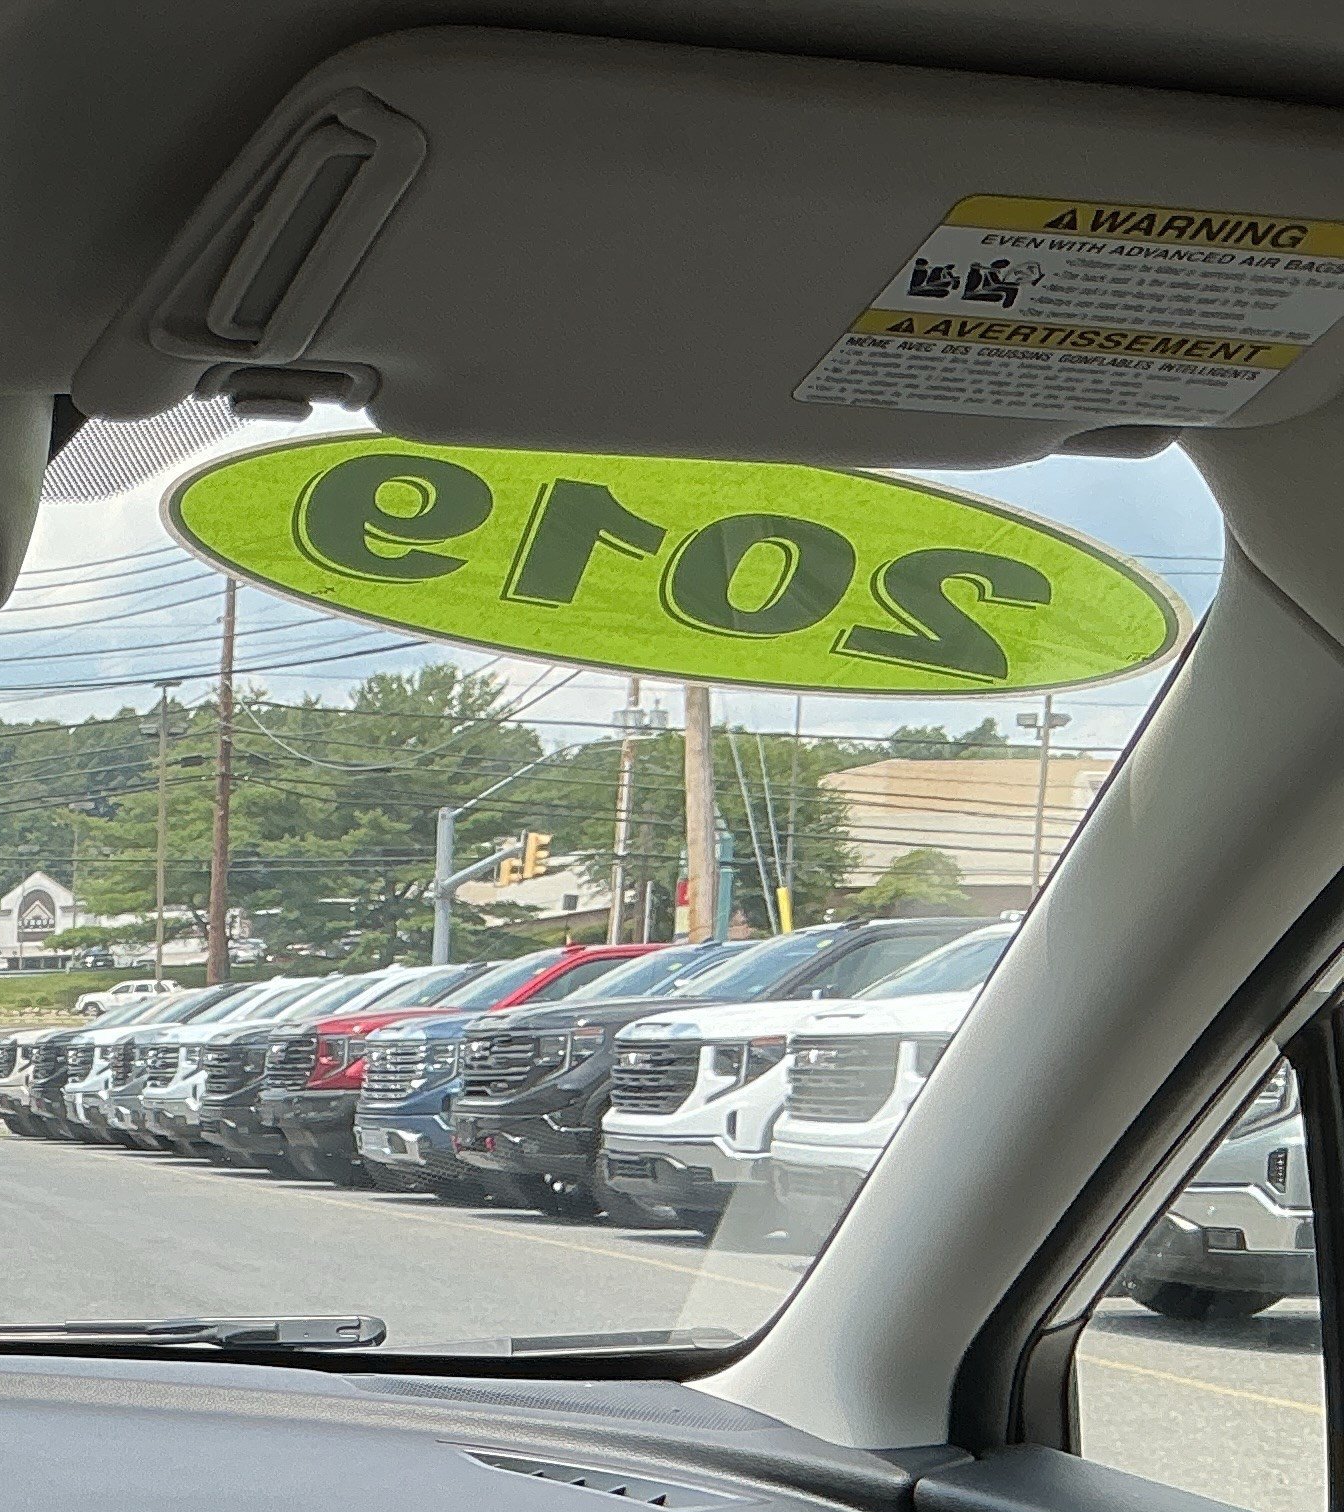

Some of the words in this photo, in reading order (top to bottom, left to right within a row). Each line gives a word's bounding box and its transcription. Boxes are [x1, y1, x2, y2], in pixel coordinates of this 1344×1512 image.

[1091, 208, 1309, 249] WARNING
[981, 234, 1044, 249] EVEN
[1048, 238, 1105, 255] WITH
[1108, 244, 1237, 266] ADVANCED
[1239, 254, 1282, 269] AIR
[1285, 259, 1344, 275] BAGS
[897, 340, 937, 353] AVEC
[941, 344, 970, 356] DES
[924, 318, 1272, 363] AVERTISSEMENT
